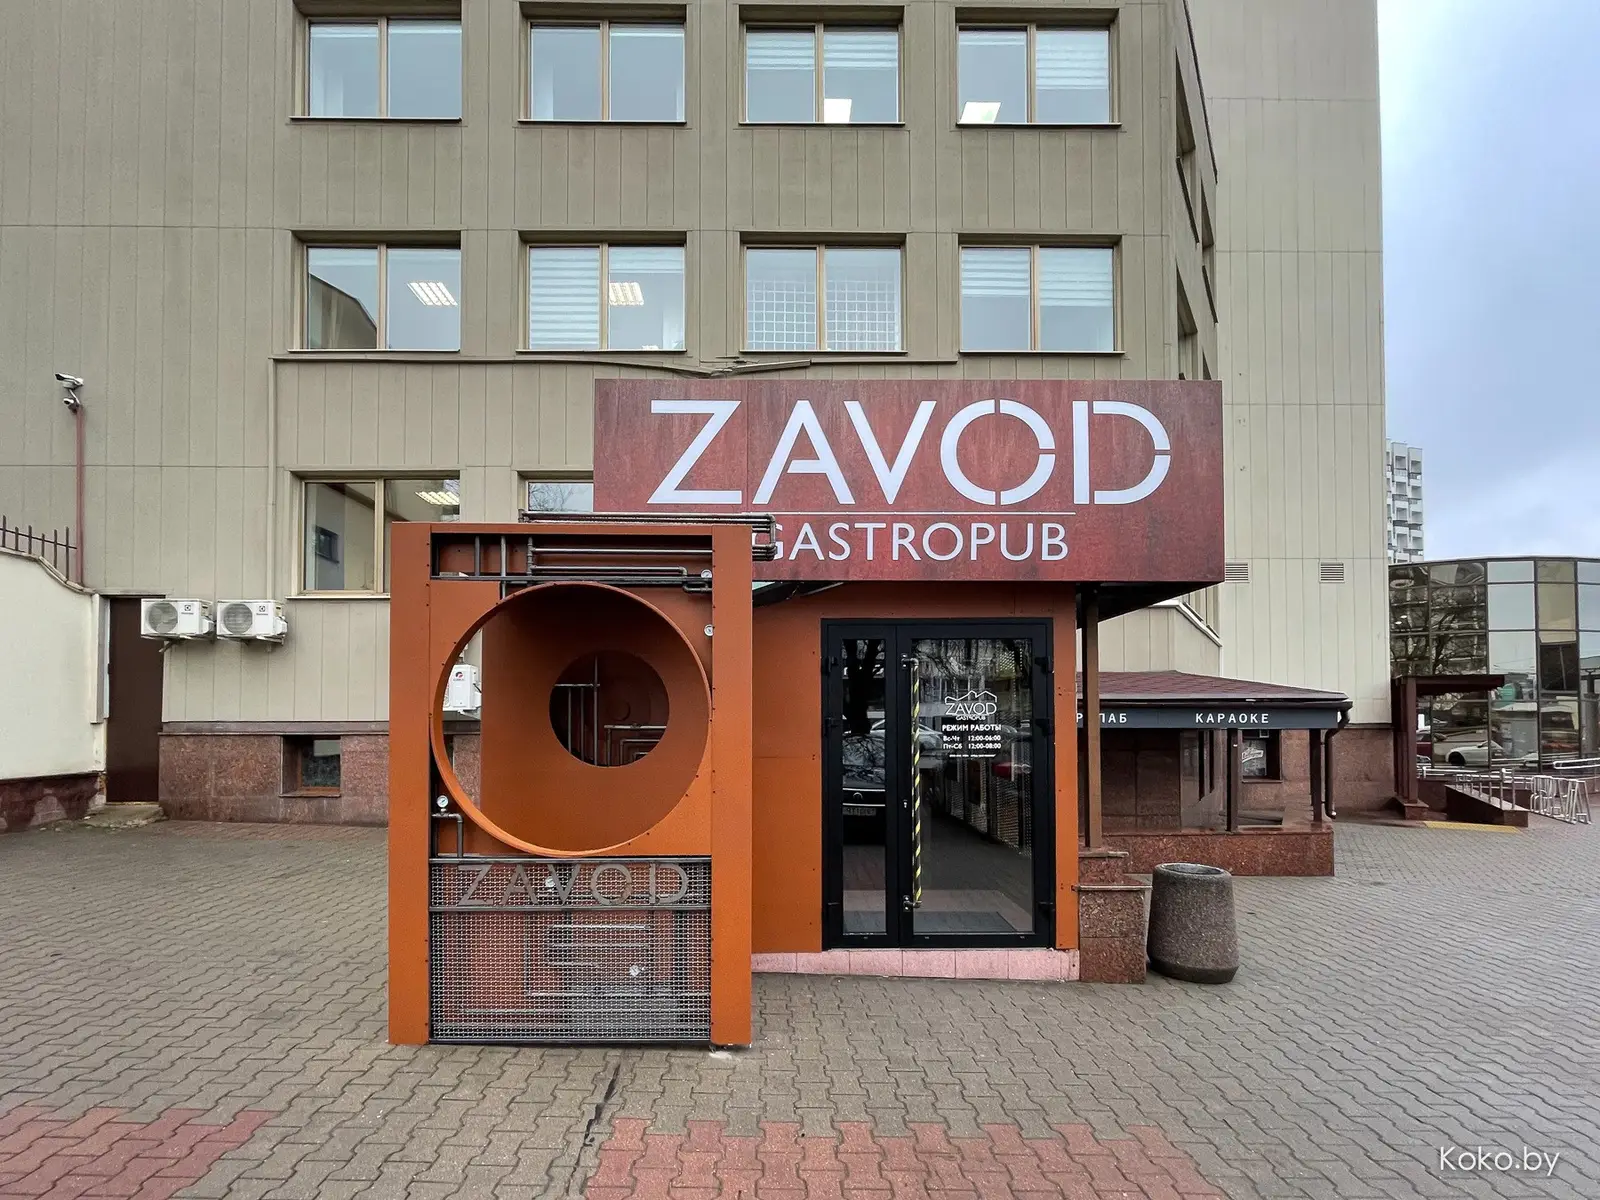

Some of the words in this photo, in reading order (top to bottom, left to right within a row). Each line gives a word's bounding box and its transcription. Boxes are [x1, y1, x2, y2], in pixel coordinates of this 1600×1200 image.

[646, 398, 1172, 506] ZAVOD
[945, 702, 997, 716] ZAVOD
[1195, 713, 1269, 724] КАРАОКЕ
[942, 724, 969, 732] РЕЖИМ
[457, 863, 690, 907] ZAVOD
